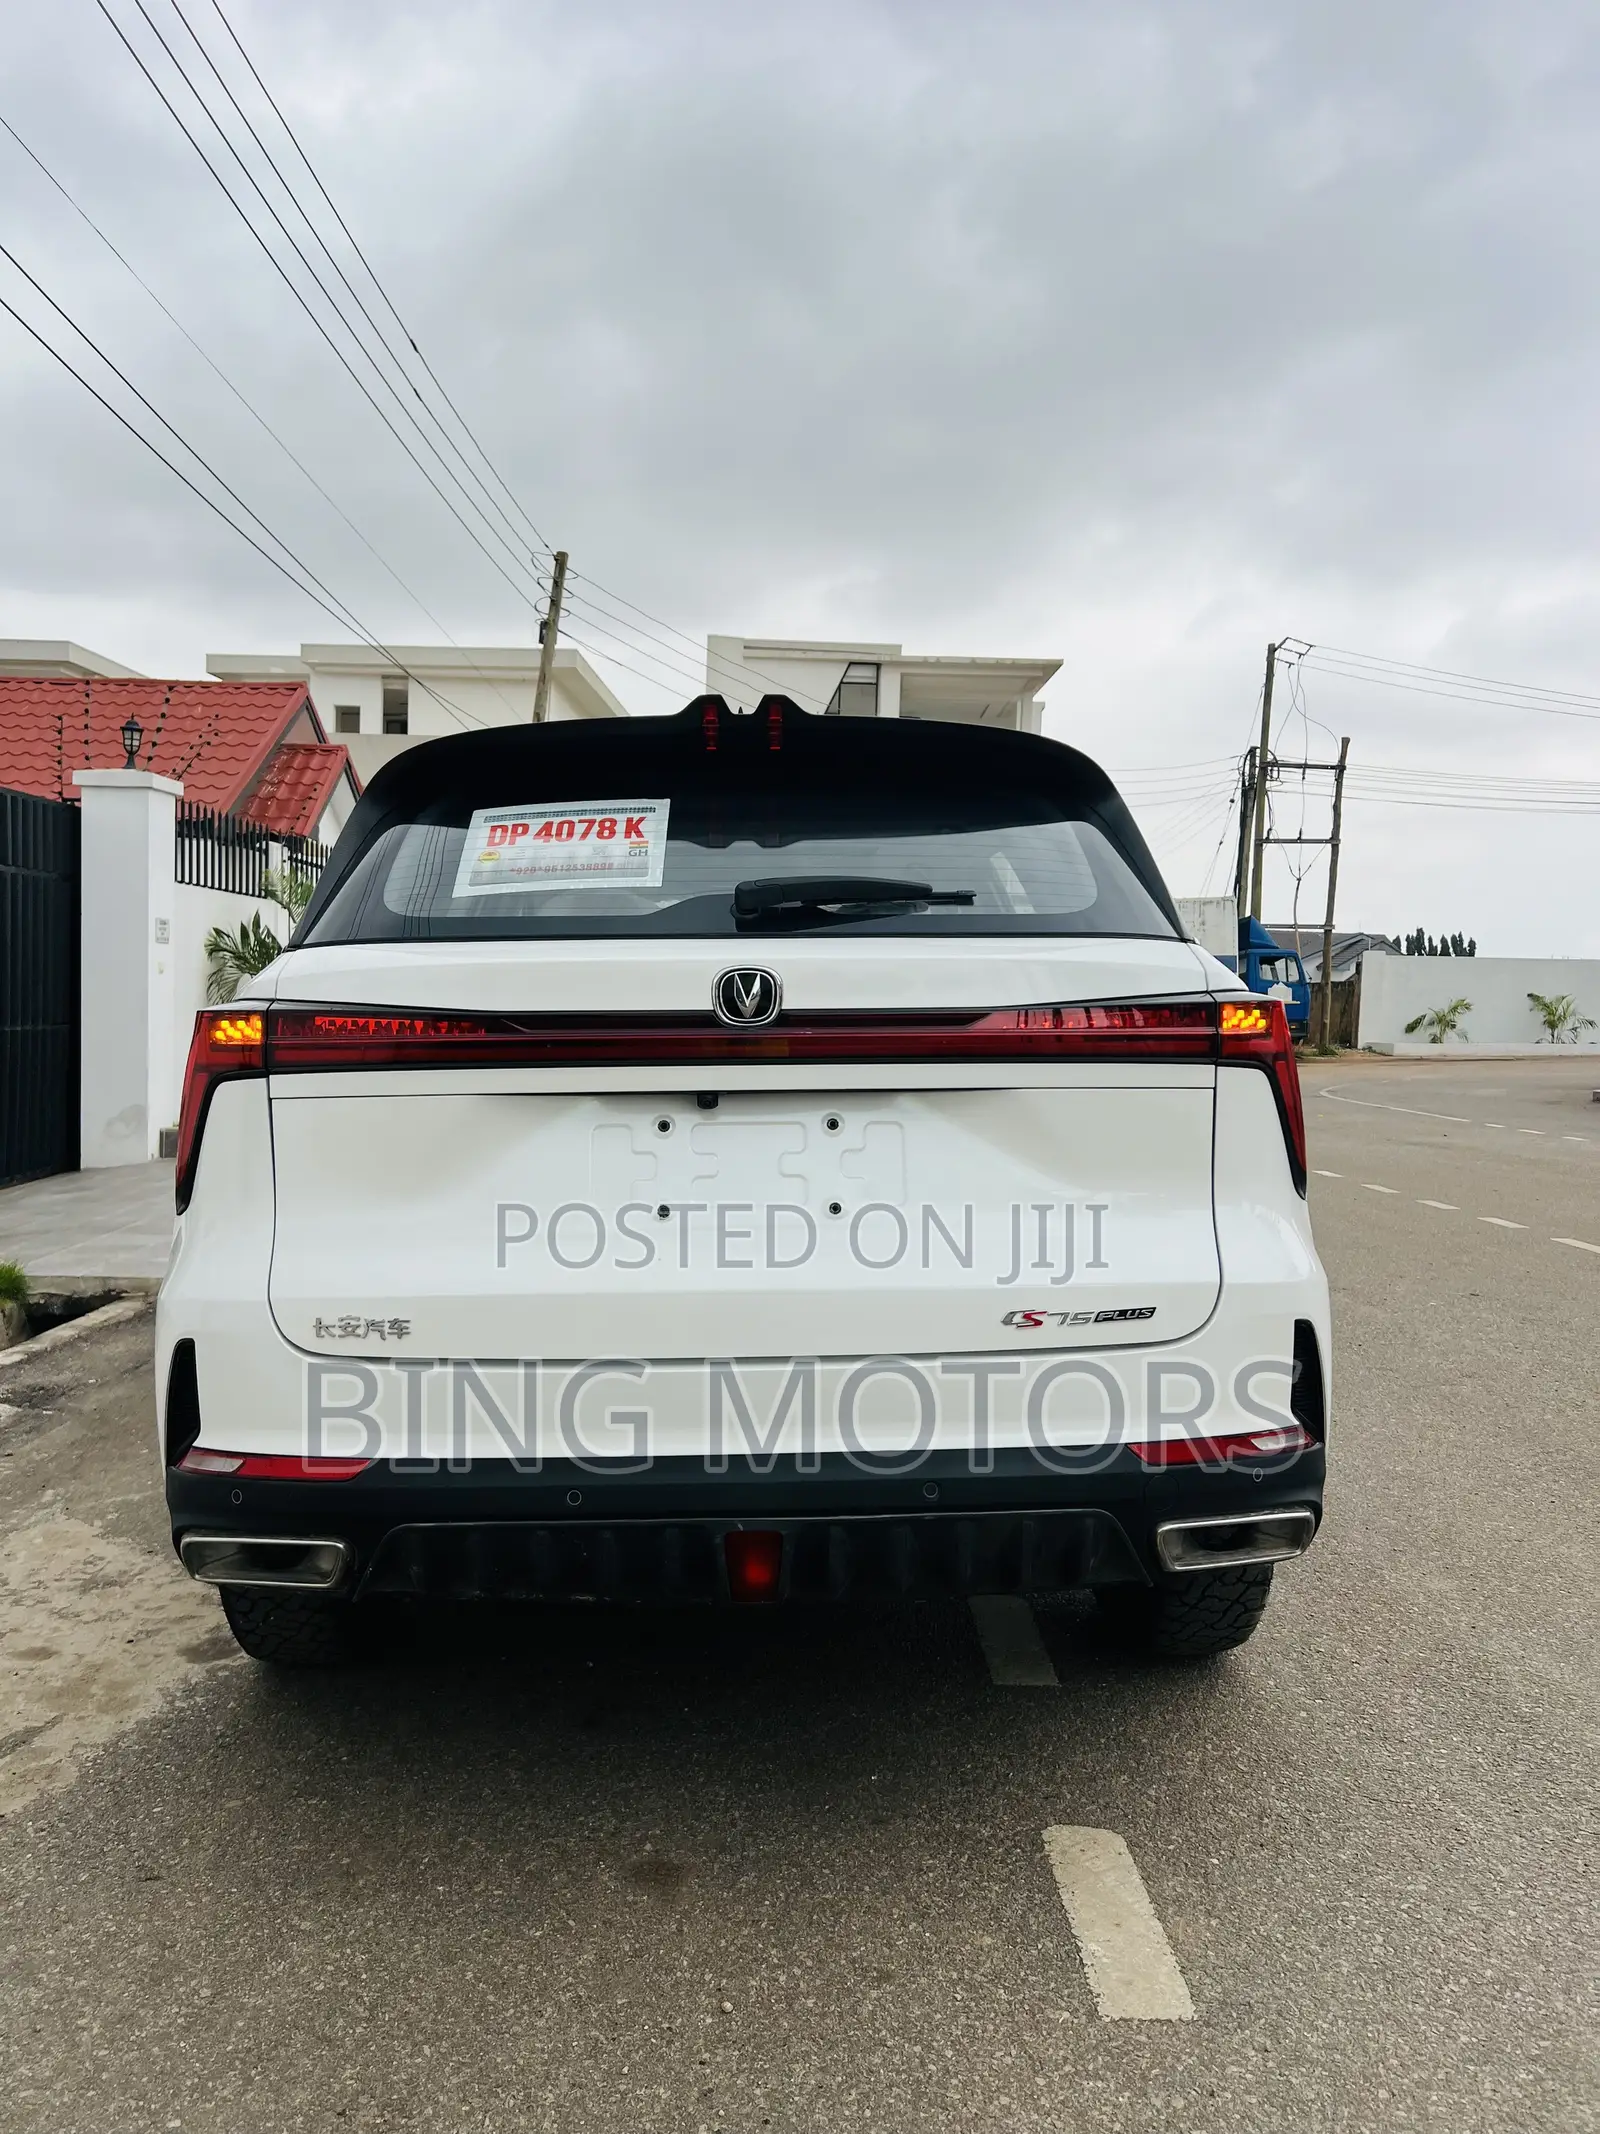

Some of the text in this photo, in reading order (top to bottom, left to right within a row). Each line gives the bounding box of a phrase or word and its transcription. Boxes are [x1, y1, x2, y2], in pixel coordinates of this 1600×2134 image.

[486, 816, 647, 847] DP 4078 K
[628, 849, 648, 857] GH
[1096, 1307, 1155, 1322] PLUS
[313, 1314, 411, 1341] 长安汽车
